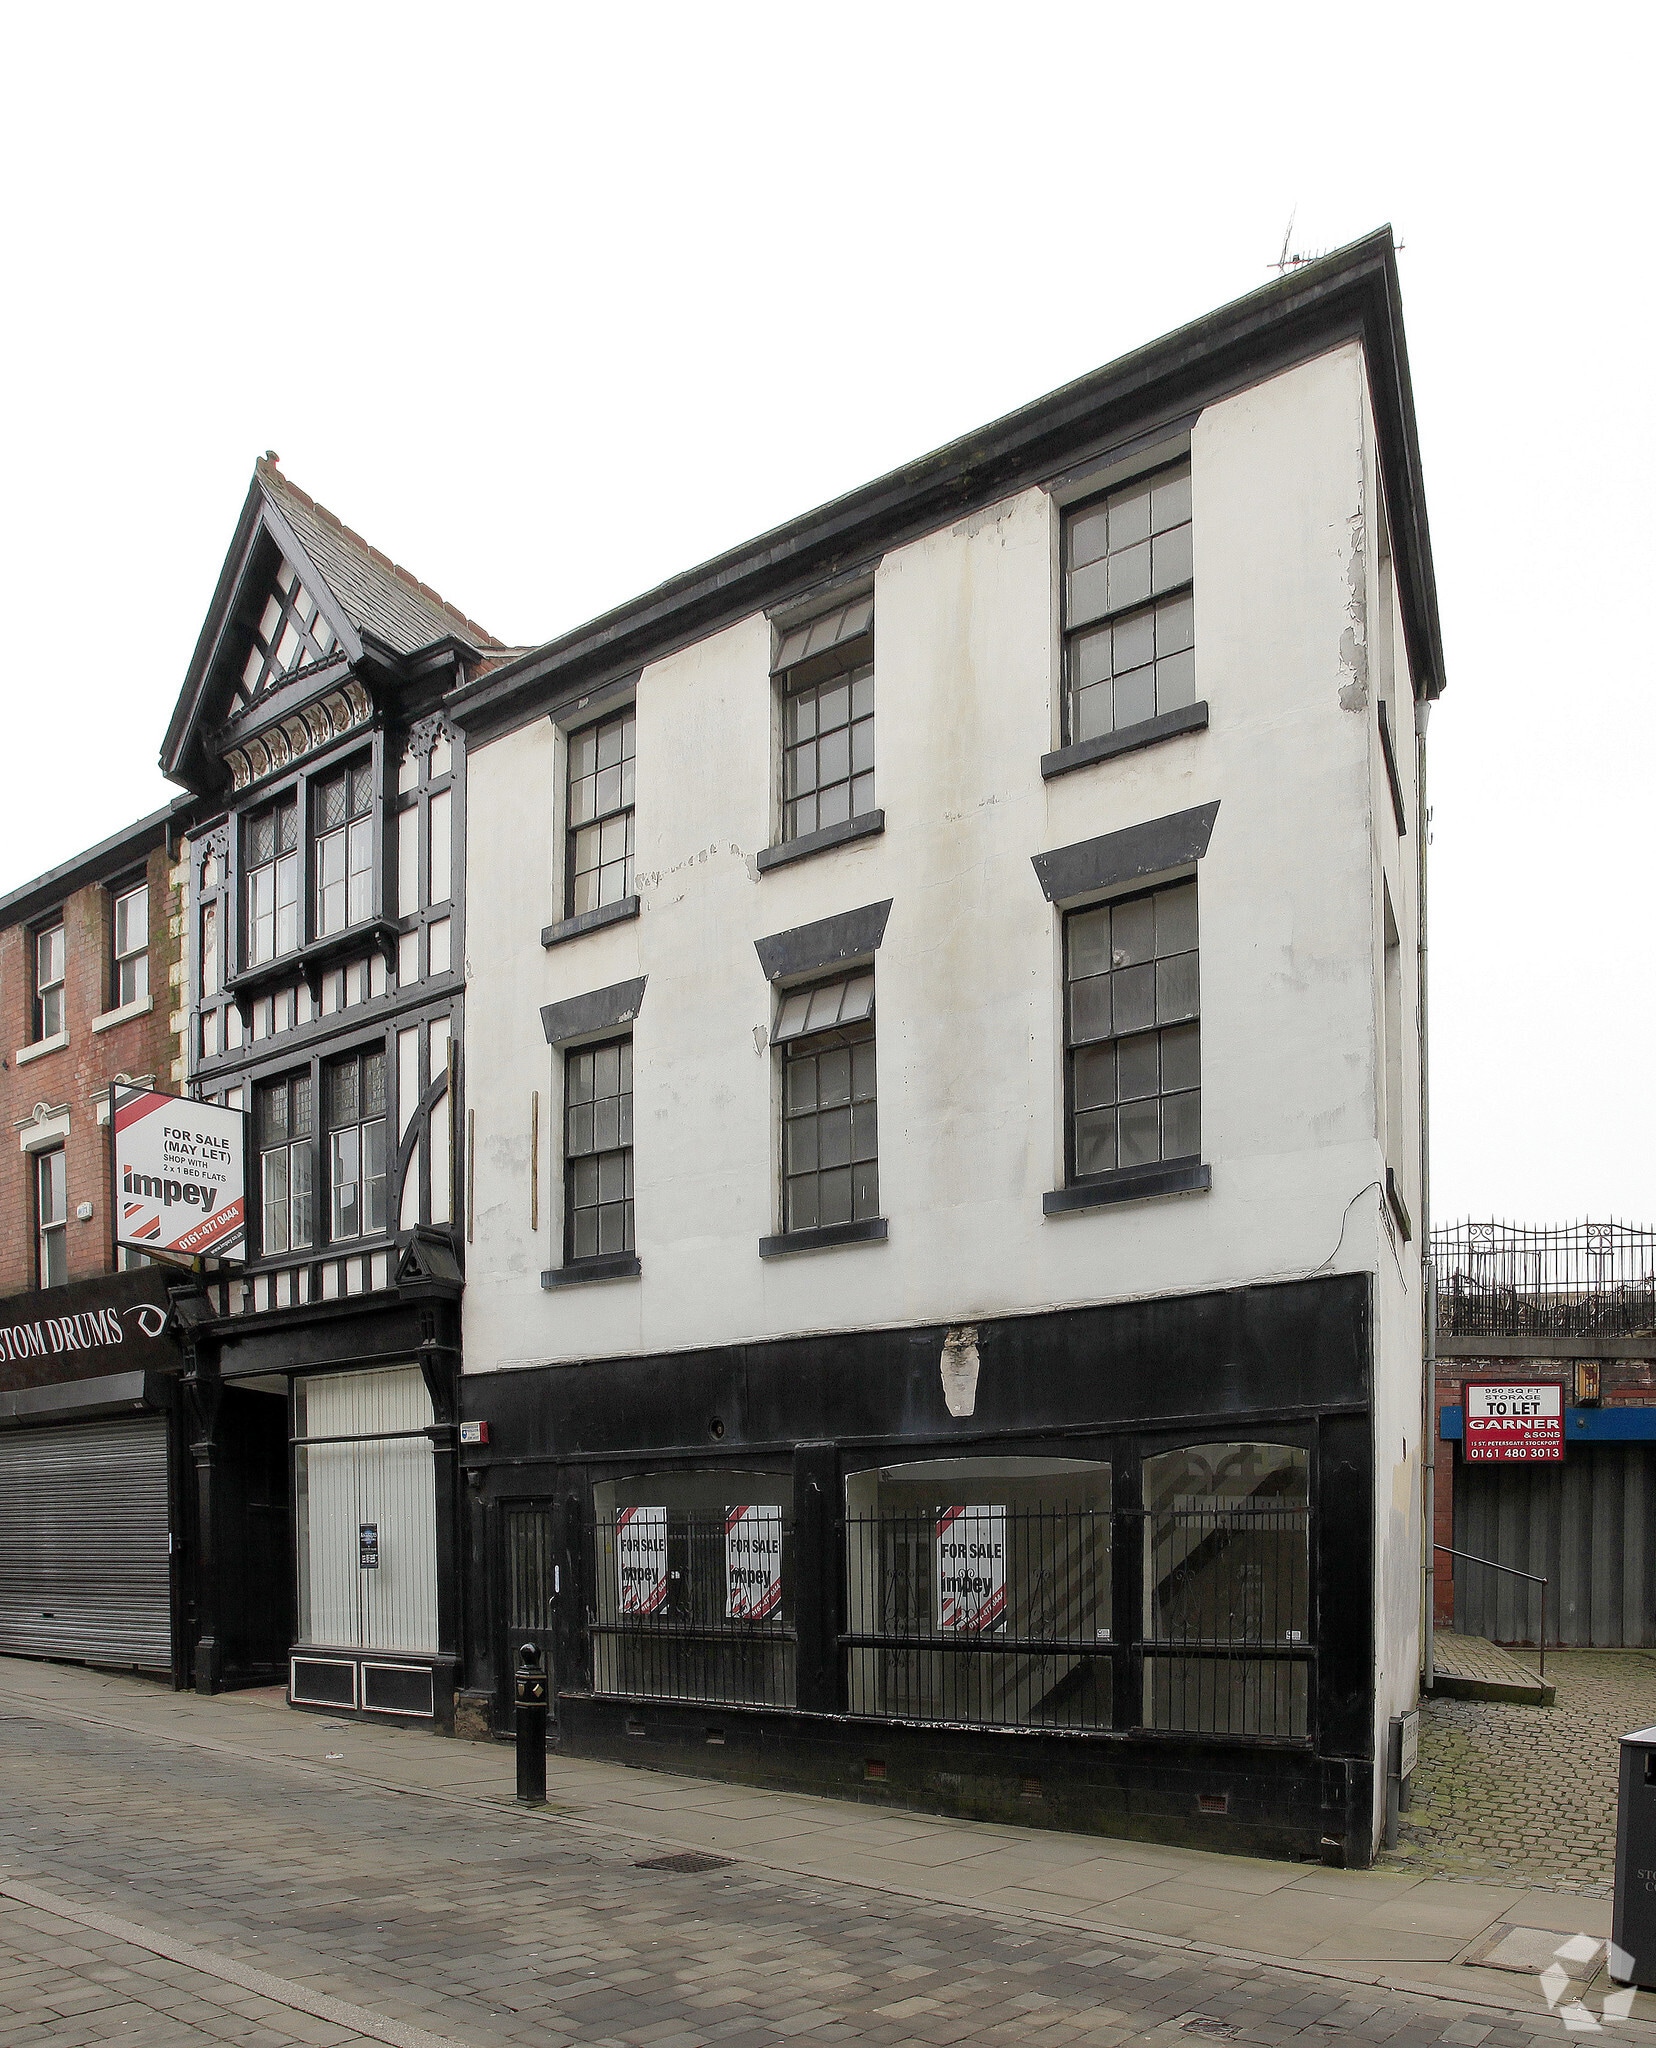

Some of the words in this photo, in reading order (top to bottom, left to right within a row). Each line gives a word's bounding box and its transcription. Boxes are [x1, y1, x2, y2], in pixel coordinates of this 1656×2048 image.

[164, 1127, 191, 1142] FOR
[195, 1133, 230, 1150] SALE
[164, 1140, 197, 1156] (MAY
[202, 1147, 231, 1165] LET)
[163, 1154, 186, 1164] SHOP
[187, 1158, 208, 1169] WITH
[163, 1163, 168, 1172] 2
[183, 1167, 200, 1177] BED
[202, 1171, 227, 1182] FLATS
[123, 1164, 217, 1213] impey
[178, 1219, 218, 1250] 0161-477
[217, 1206, 240, 1225] 0444
[46, 1307, 123, 1353] DRUMS
[1486, 1402, 1507, 1415] TO
[1512, 1402, 1541, 1415] LET
[1469, 1419, 1560, 1430] GARNER
[1471, 1449, 1500, 1458] 0161
[1504, 1449, 1527, 1458] 480
[1530, 1448, 1560, 1458] 3013
[622, 1539, 639, 1552] FOR
[640, 1539, 665, 1552] SALE
[730, 1540, 750, 1553] FOR
[752, 1540, 779, 1554] SALE
[941, 1544, 967, 1558] FOR
[969, 1544, 1002, 1559] SALE
[1645, 1881, 1656, 1892] C
